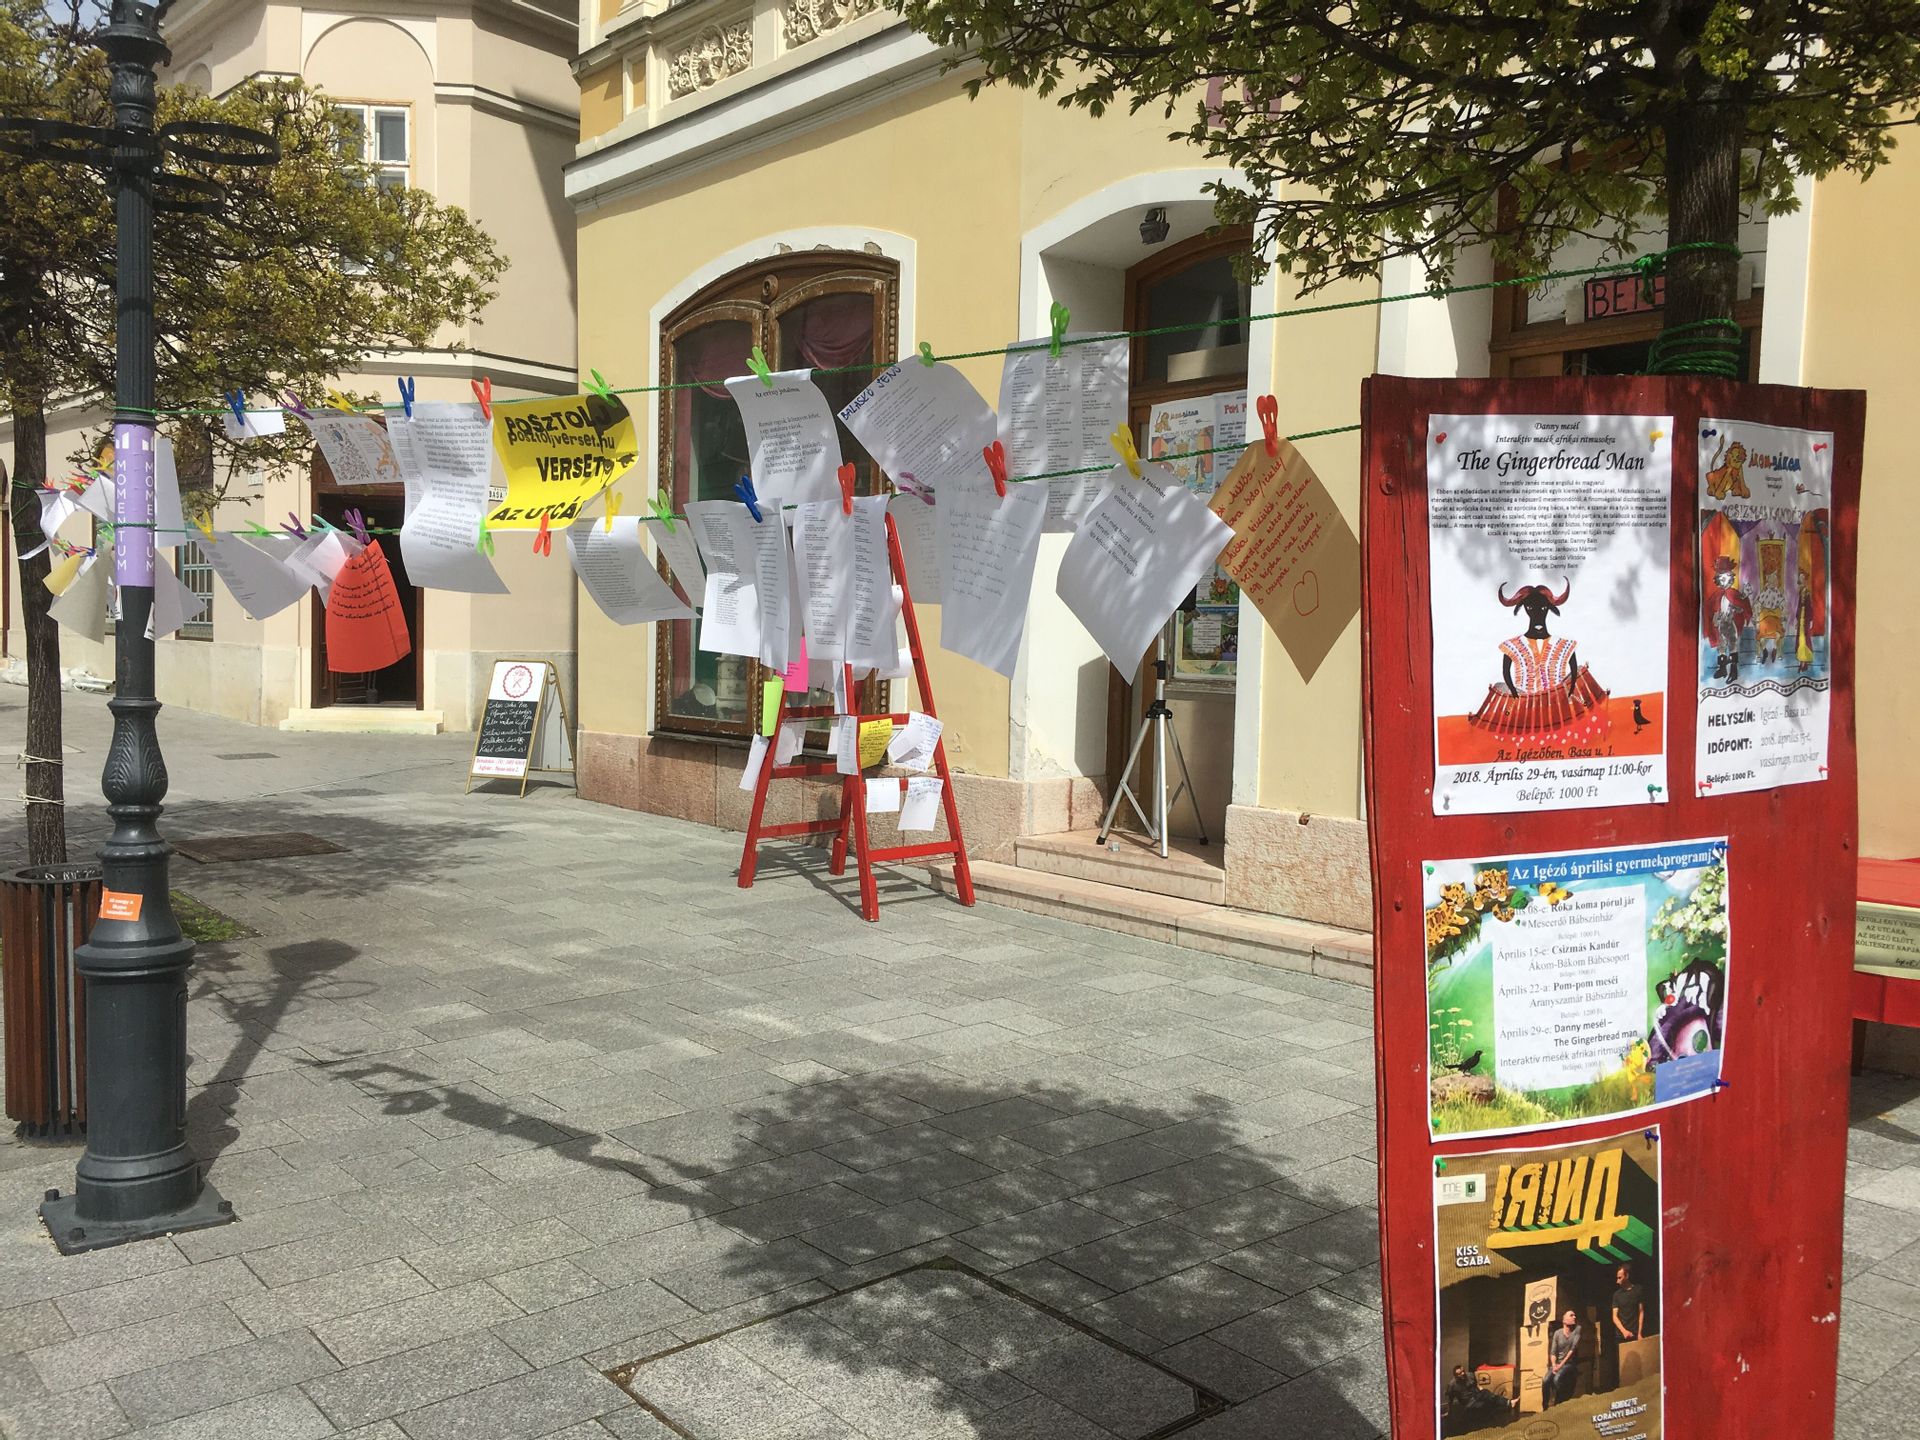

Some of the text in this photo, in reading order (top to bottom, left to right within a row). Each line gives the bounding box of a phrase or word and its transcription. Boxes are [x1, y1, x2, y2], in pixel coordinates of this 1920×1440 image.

[1534, 421, 1581, 432] Danny mesél
[508, 430, 615, 449] posztoljverset.hu
[1495, 434, 1616, 446] Interaktív mesék afrikai ritmusokra
[1457, 449, 1645, 477] The Gingerbread Man
[116, 460, 127, 571] MOMENTUM
[145, 462, 154, 572] MOMENTUM
[490, 496, 582, 520] AZ UTCÁ
[1708, 707, 1756, 727] HELYSZÍN:
[1493, 745, 1615, 764] Az Igézőben, Basa u. 1.
[1452, 761, 1653, 785] 2018. Április 29-én, vasárnap 11:00-kor
[1732, 772, 1746, 780] 1000
[1515, 785, 1598, 804] Belépő: 1000 Ft
[1511, 849, 1718, 881] Az Igéző áprilisi gyermekprogramj
[1551, 902, 1573, 913] Róka
[1575, 901, 1598, 911] koma
[1600, 898, 1623, 909] pórul
[1623, 896, 1635, 908] jár
[1569, 912, 1614, 925] Bábszínház
[1497, 948, 1526, 961] Április
[1552, 945, 1587, 955] Csizmás
[1589, 940, 1620, 951] Kandúr
[1528, 953, 1630, 972] Ákom-Bákom Bábcsoport
[1498, 984, 1527, 998] Április
[1553, 980, 1594, 991] Pom-pom
[1595, 975, 1619, 986] meséi
[1529, 989, 1628, 1008] Aranyszamár Bábszínház
[1499, 1026, 1529, 1040] Április
[1554, 1023, 1581, 1033] Danny
[1583, 1018, 1607, 1030] mesél
[1554, 1030, 1638, 1047] The Gingerbread man
[1500, 1048, 1597, 1067] Interaktív mesék afrikai
[1456, 1245, 1479, 1256] KISS
[1456, 1255, 1491, 1267] CSABA
[1592, 1404, 1648, 1423] KORÁNYI BÁLINT
